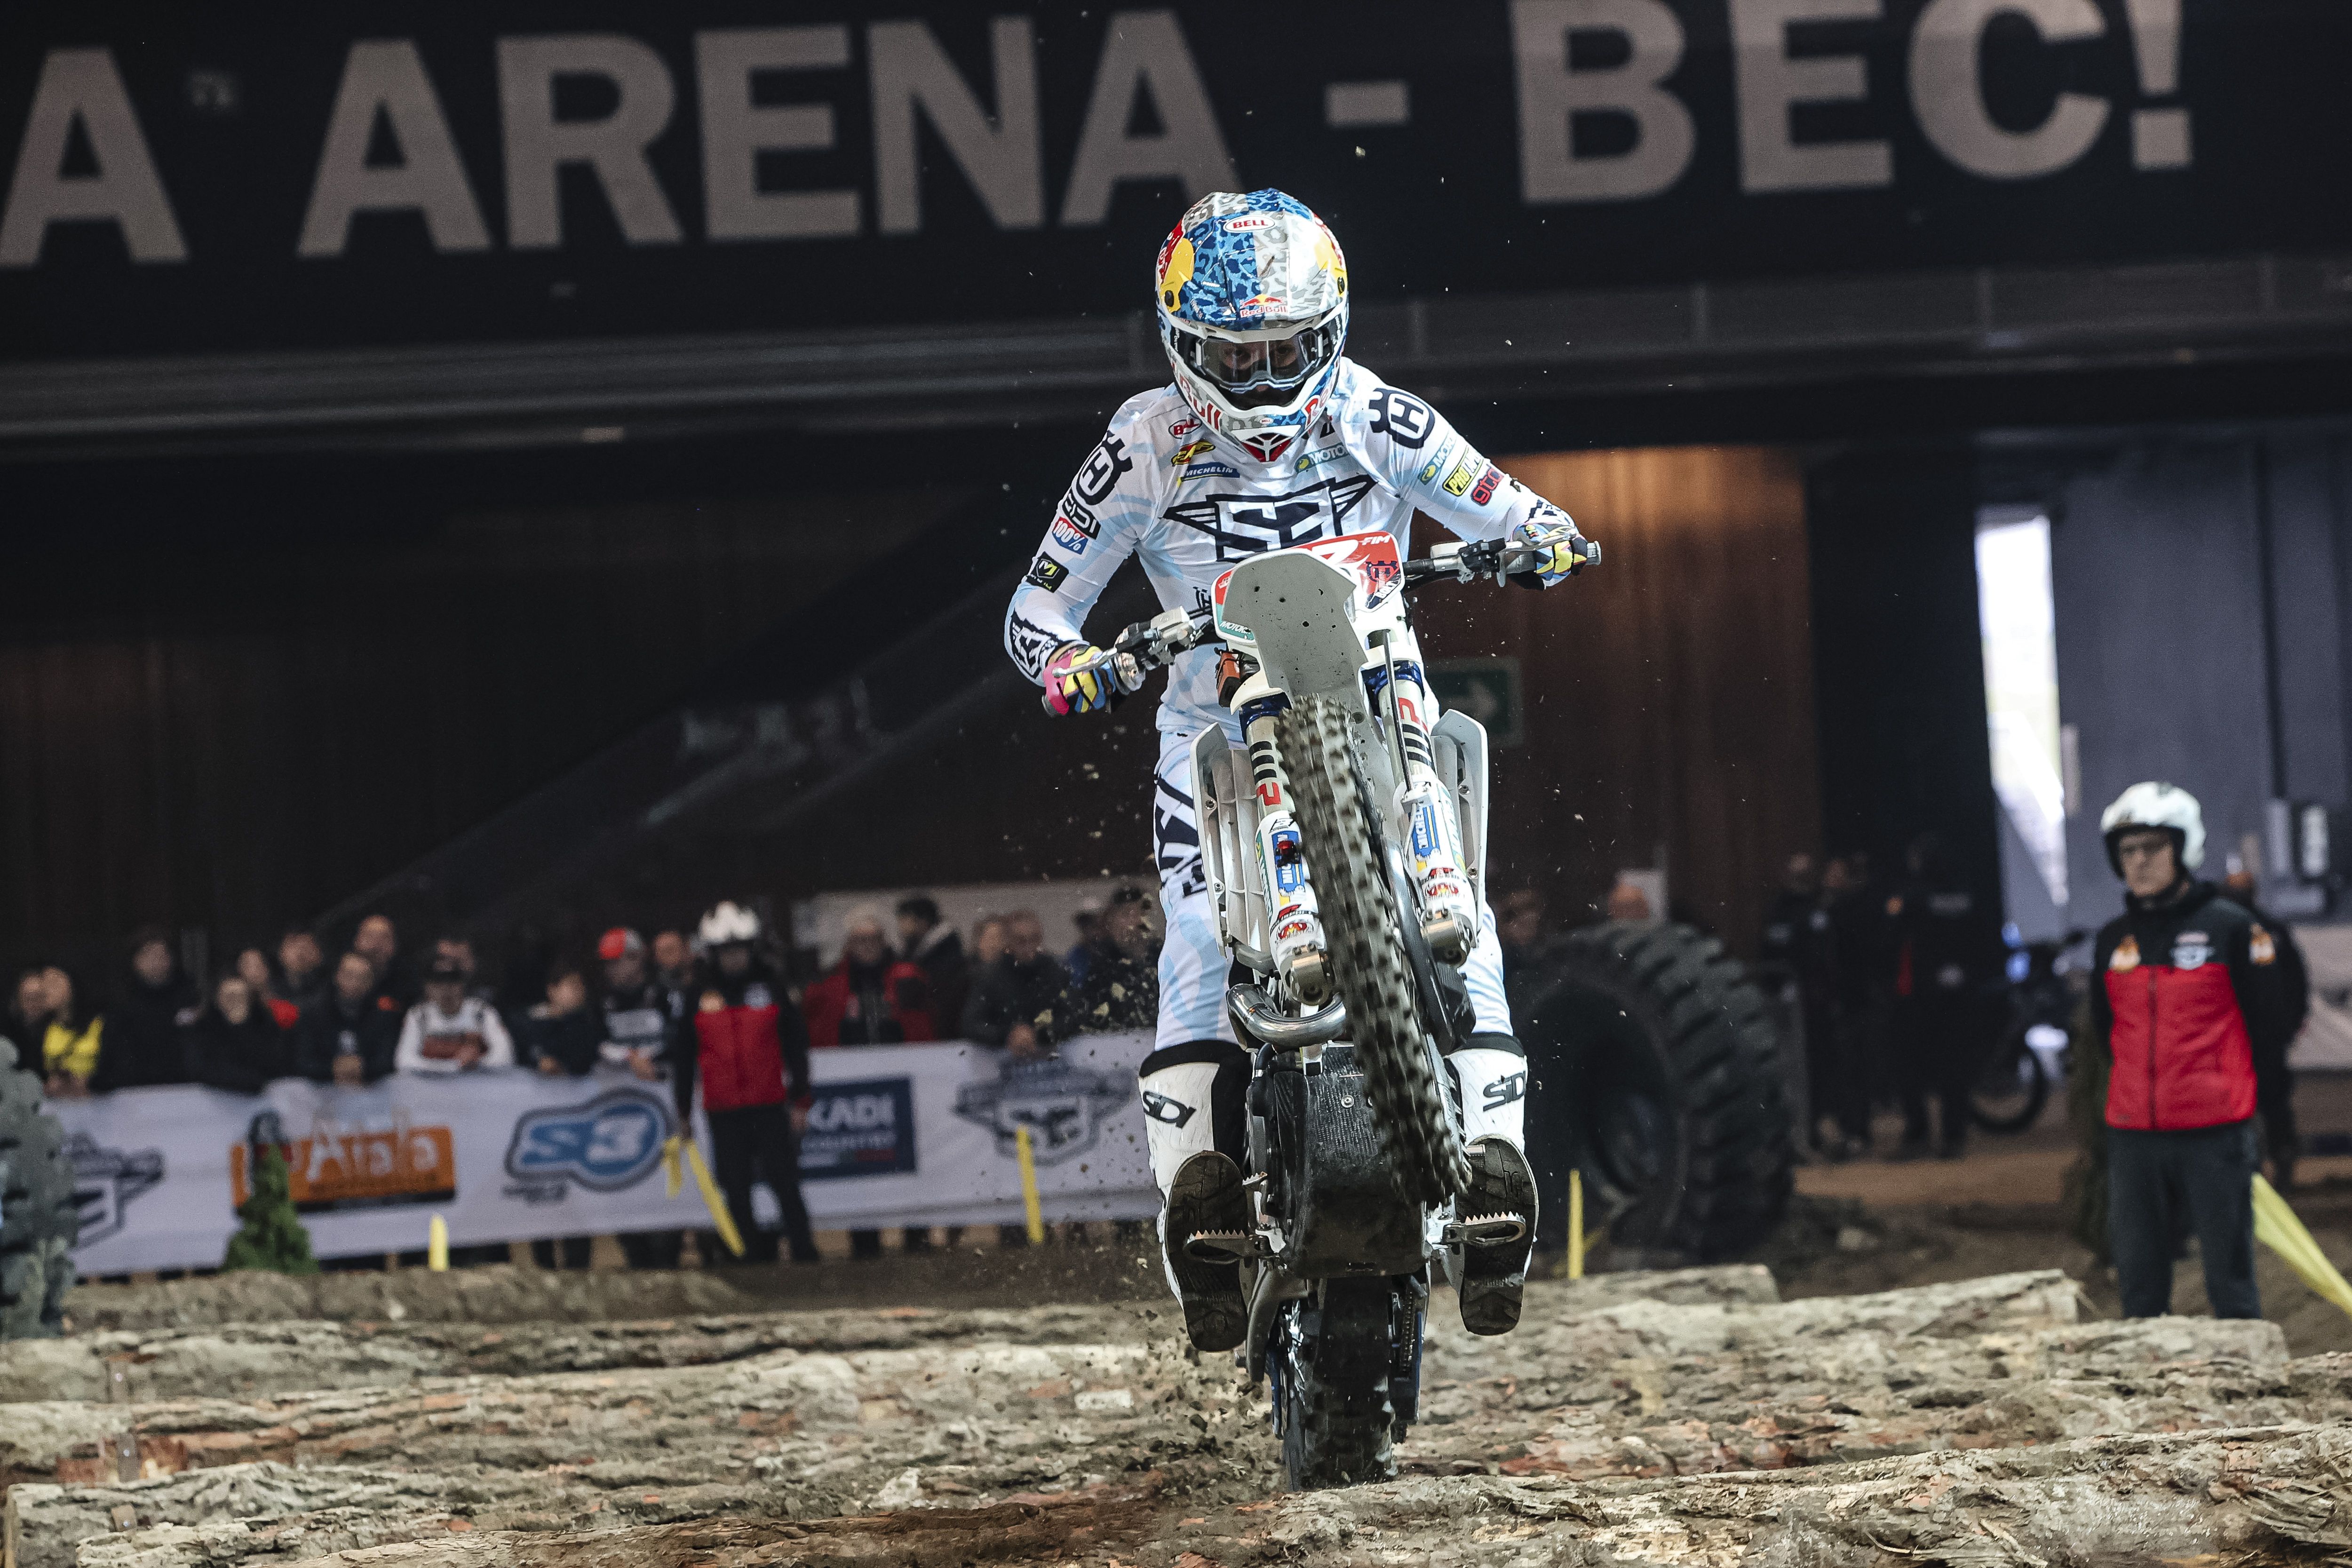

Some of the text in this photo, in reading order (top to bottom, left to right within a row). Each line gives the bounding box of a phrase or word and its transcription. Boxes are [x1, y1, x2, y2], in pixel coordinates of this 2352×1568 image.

[296, 8, 1243, 259] ARENA
[1508, 0, 2194, 204] BEC!
[1232, 218, 1269, 229] BELL
[1240, 306, 1264, 318] Red
[1179, 372, 1222, 432] Bull
[1185, 466, 1233, 476] MICHELIN
[1053, 520, 1086, 551] 100%
[1361, 534, 1391, 546] FIM
[1142, 1090, 1197, 1129] SIDI
